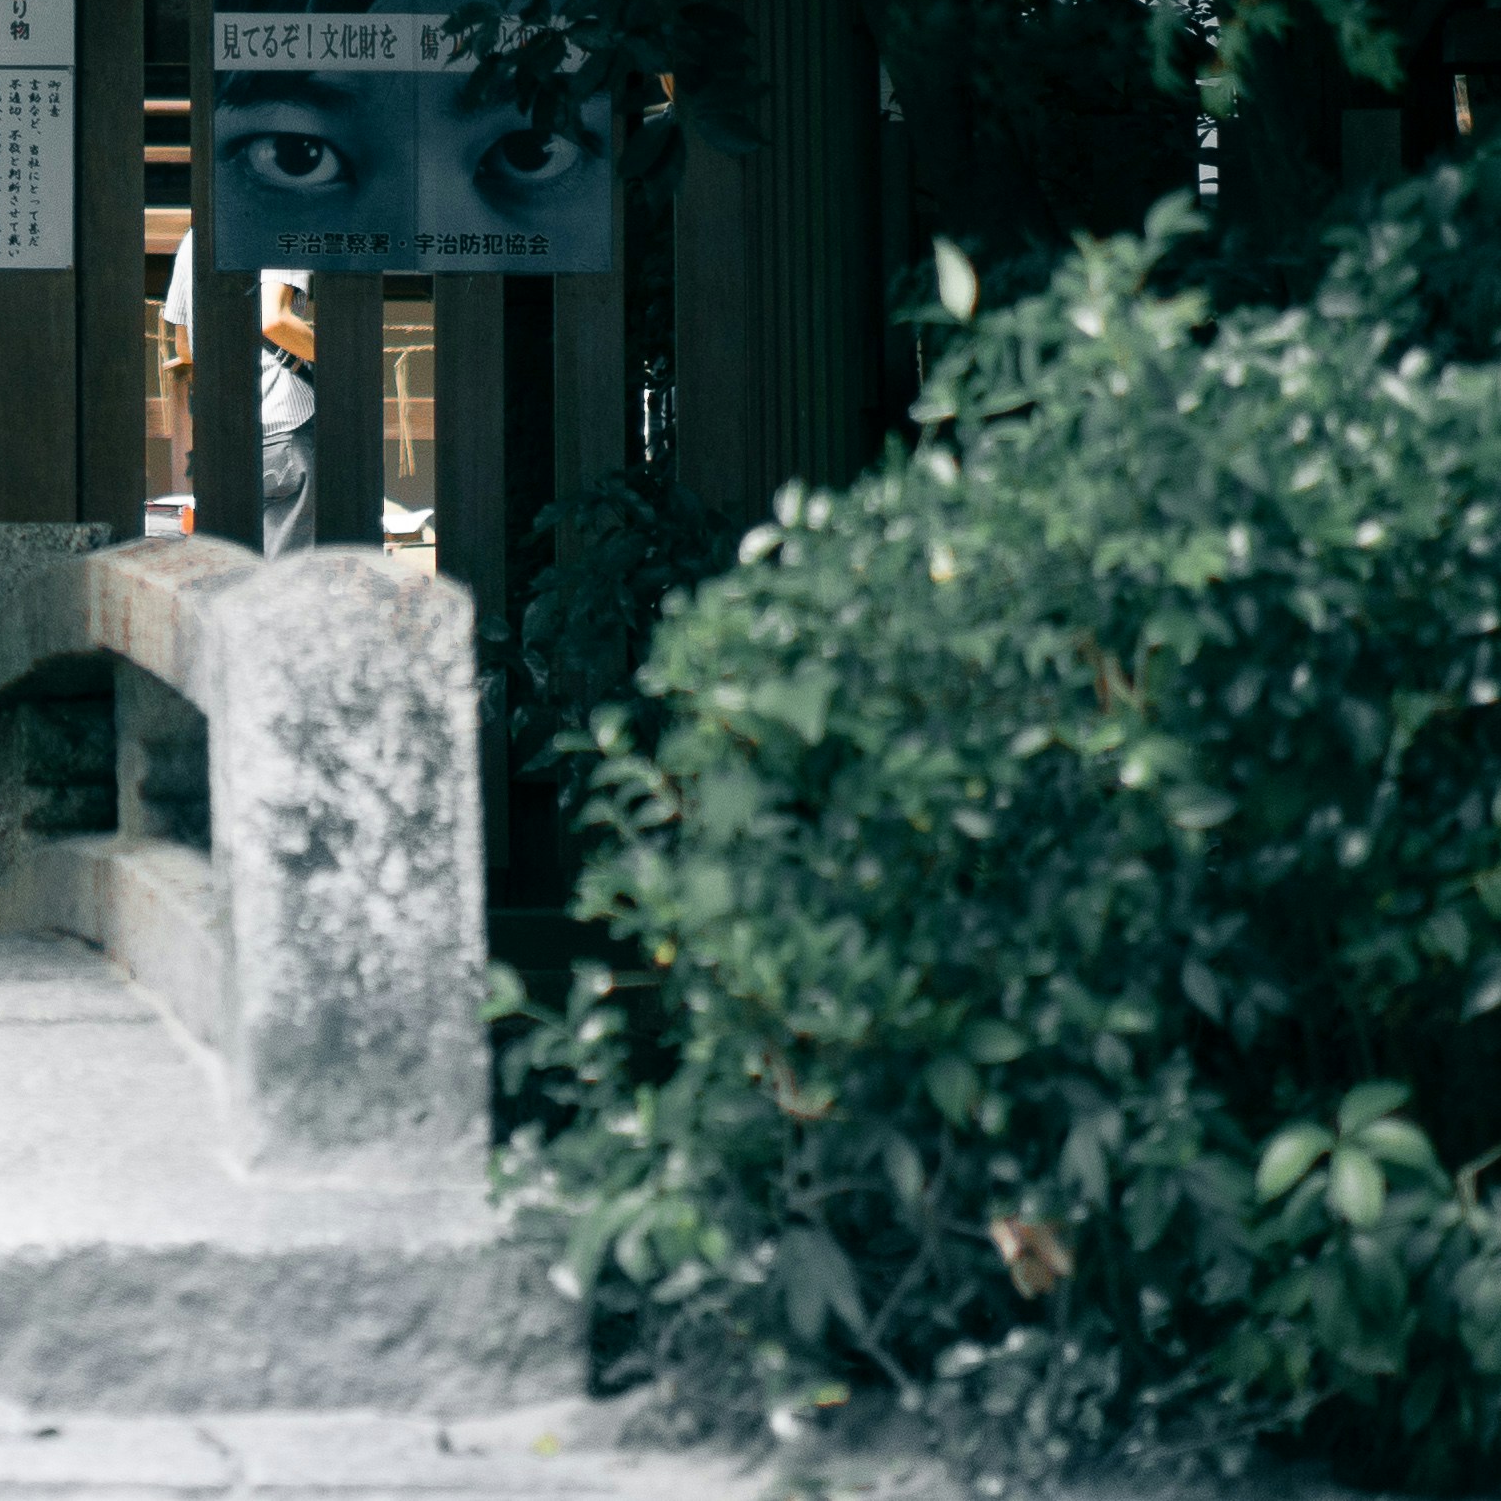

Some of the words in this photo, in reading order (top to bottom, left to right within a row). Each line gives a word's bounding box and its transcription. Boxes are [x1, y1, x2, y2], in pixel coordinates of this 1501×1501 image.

[47, 79, 62, 118] 御注意
[277, 233, 550, 256] 宇治警察署・宇治防犯協会
